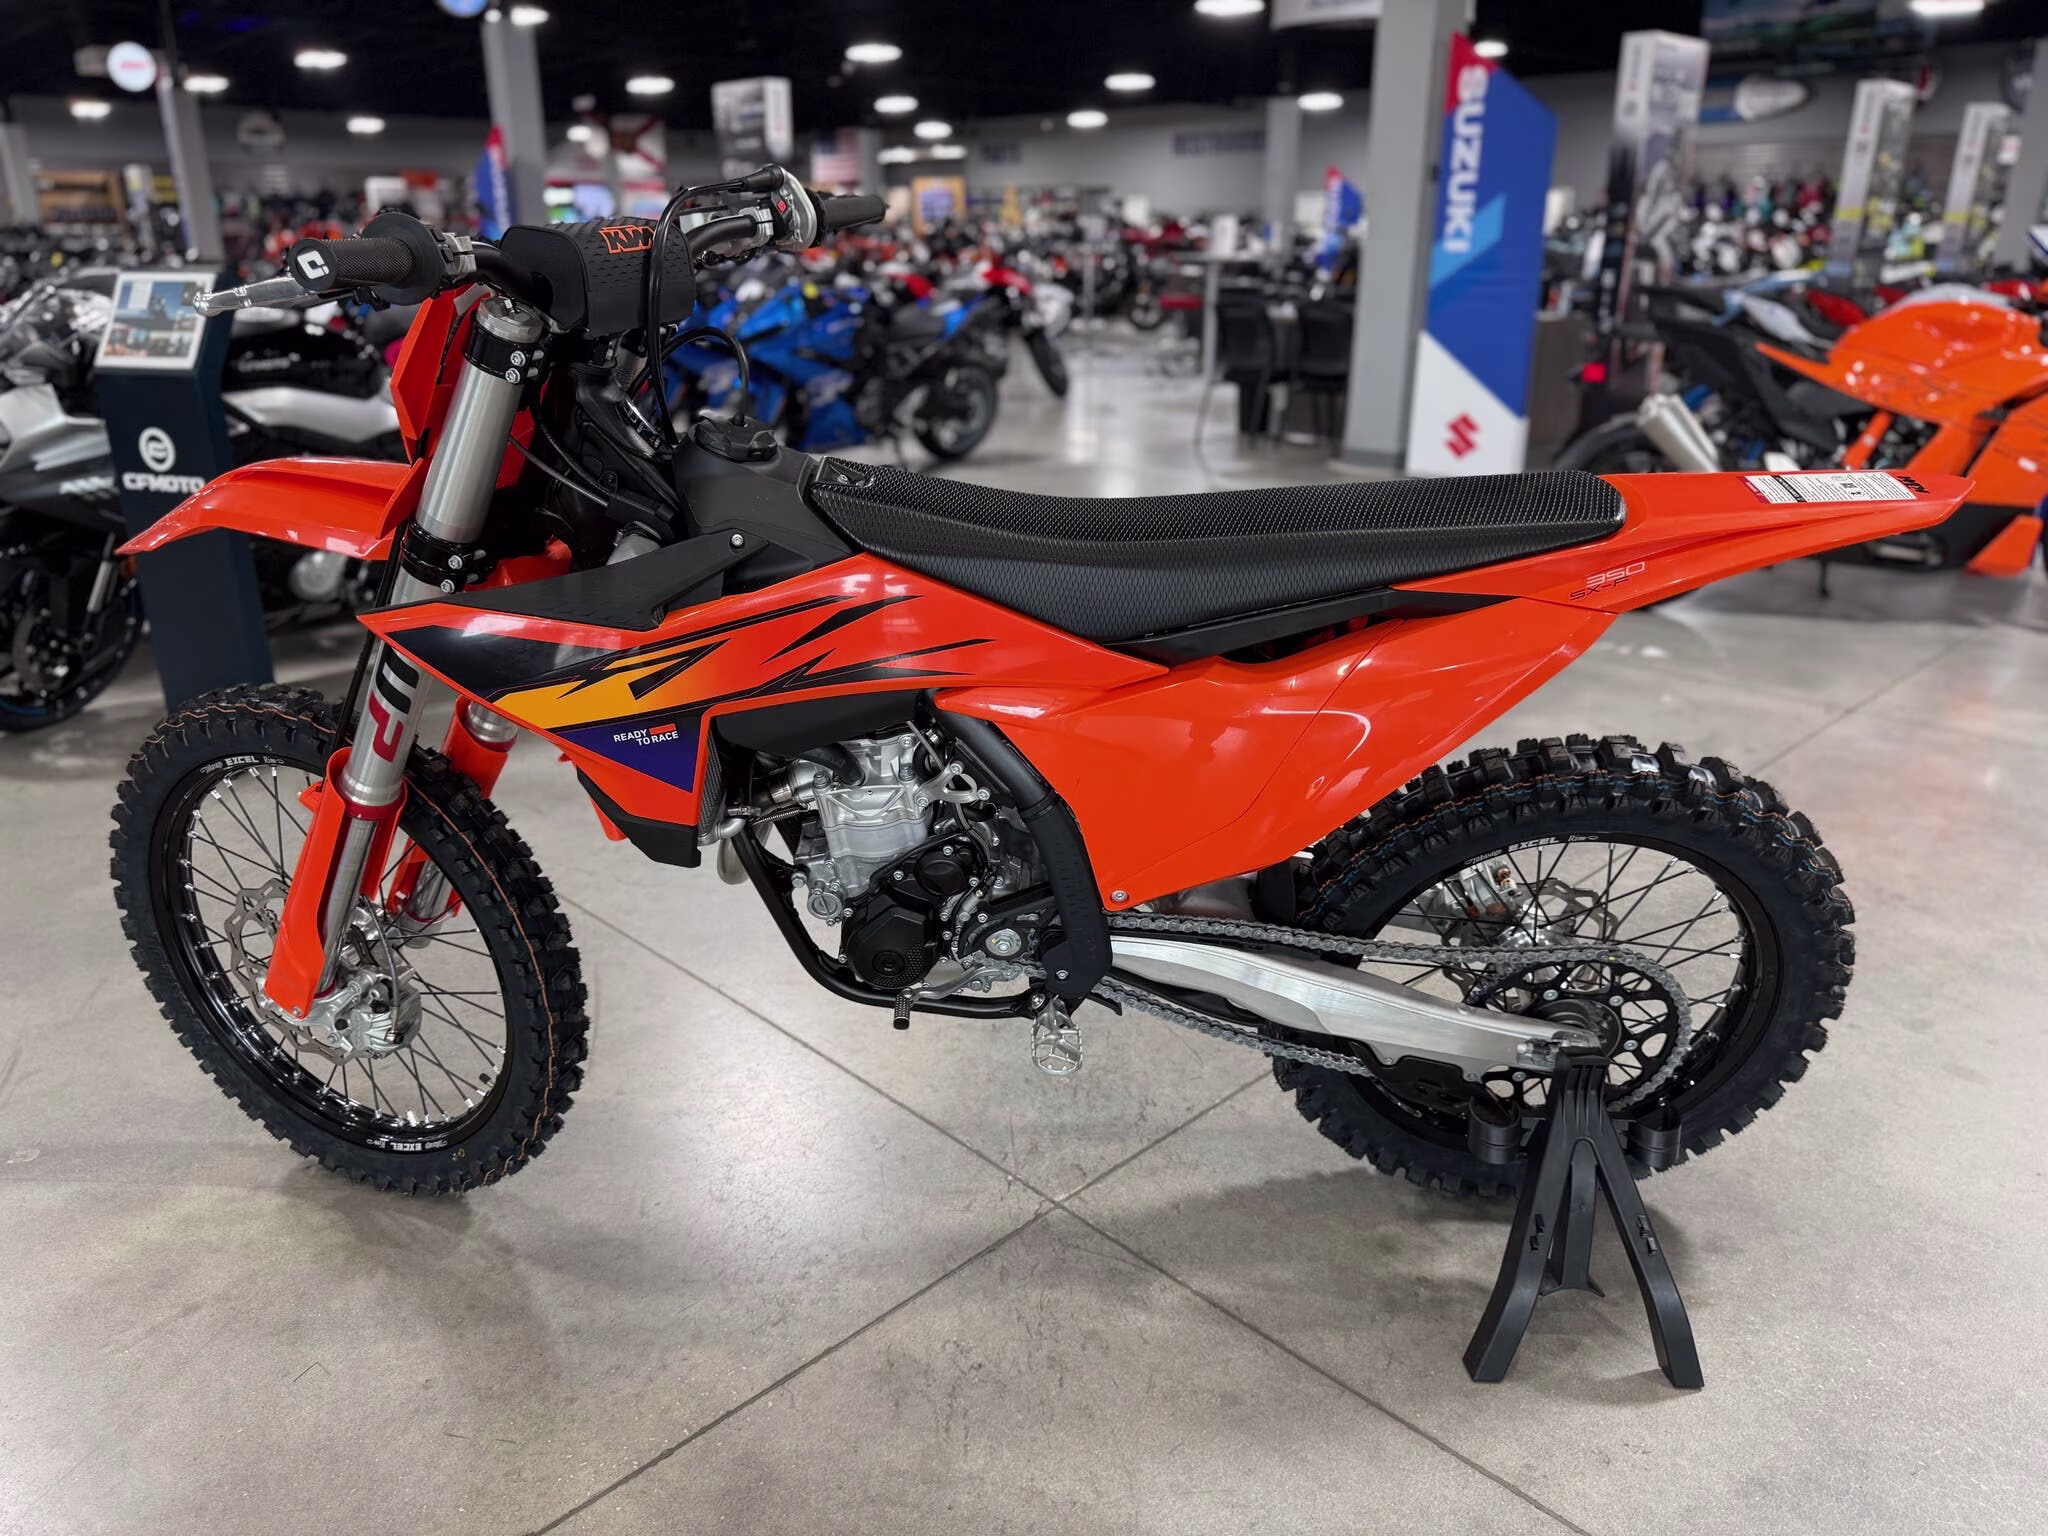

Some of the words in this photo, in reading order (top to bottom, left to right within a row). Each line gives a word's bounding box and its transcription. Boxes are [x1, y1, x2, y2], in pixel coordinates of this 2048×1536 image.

[1443, 64, 1489, 253] SUZUKI
[599, 224, 654, 253] KTM
[122, 472, 206, 494] CFMOTO
[1586, 561, 1646, 588] 350
[1570, 576, 1629, 600] SX-F
[613, 728, 647, 742] READY
[636, 737, 651, 746] TO
[651, 731, 679, 743] RACE
[224, 755, 259, 766] EXCEL
[1508, 837, 1560, 852] EXCEL
[390, 1142, 422, 1151] EXCEL
